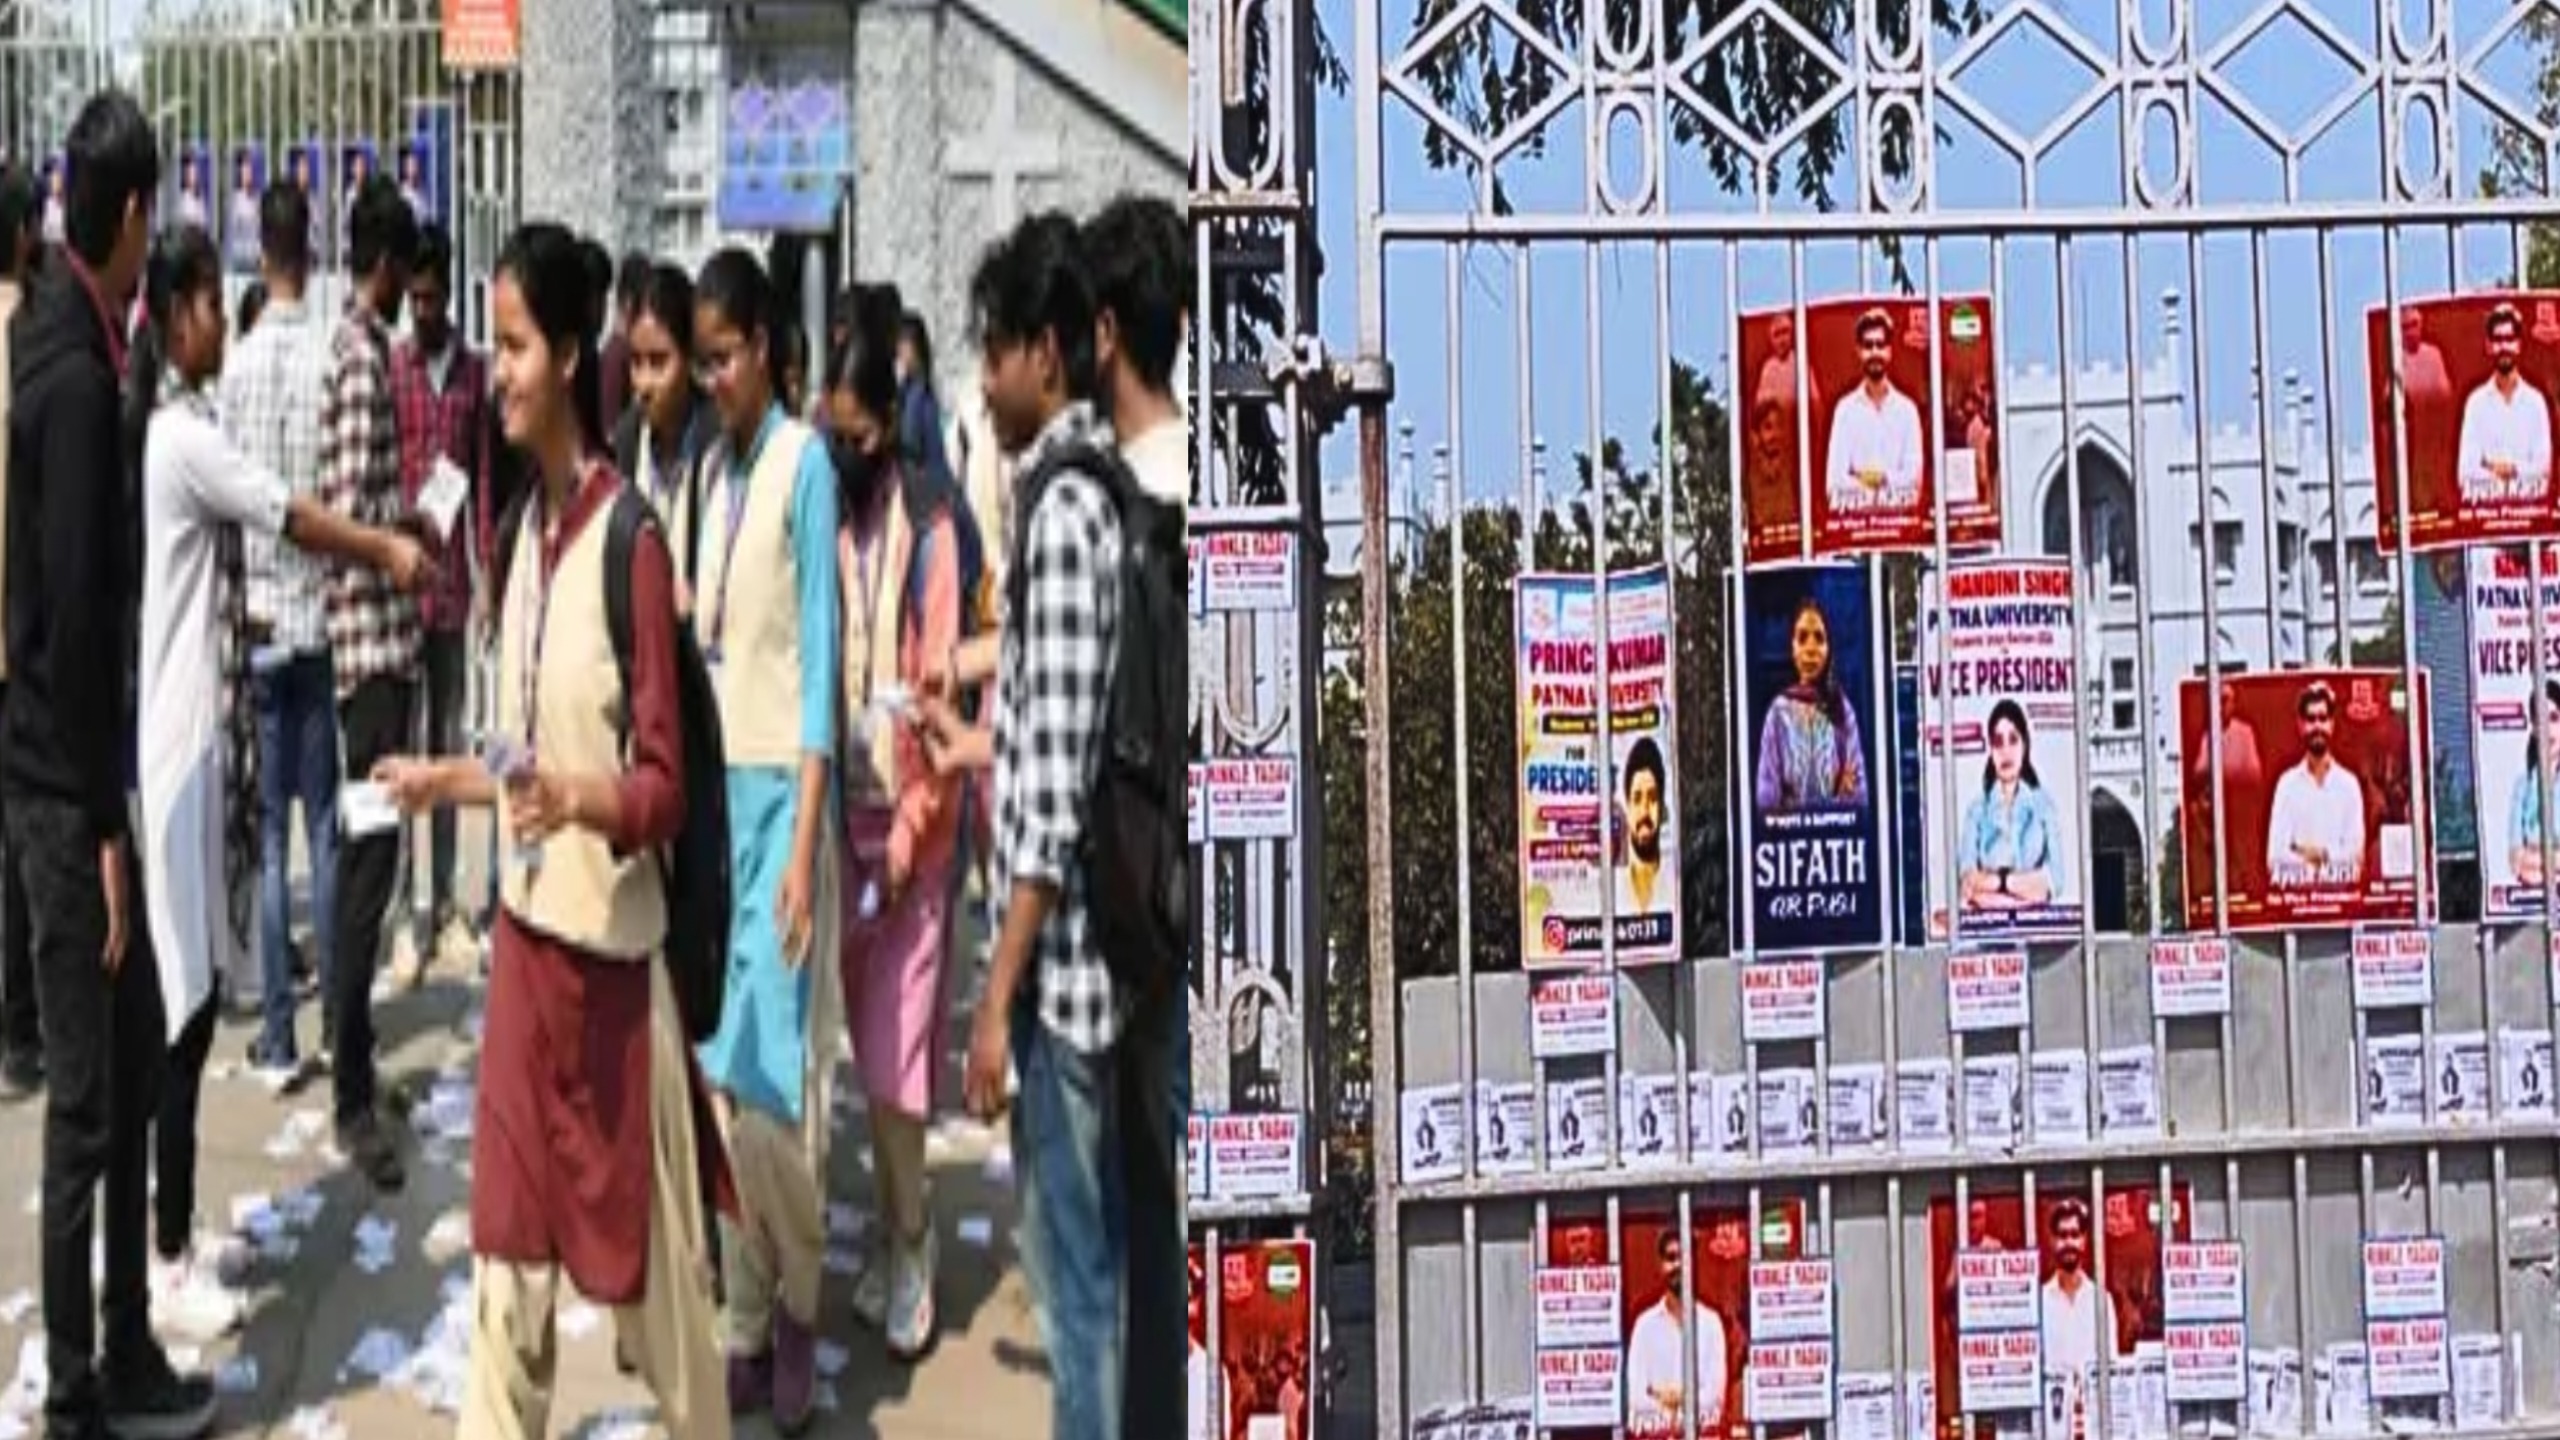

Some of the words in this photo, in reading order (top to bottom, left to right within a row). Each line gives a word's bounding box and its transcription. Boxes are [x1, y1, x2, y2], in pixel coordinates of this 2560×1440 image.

[1950, 571, 2020, 599] NANDINI
[2024, 569, 2073, 598] SINGH
[2477, 585, 2523, 609] PATNA
[1928, 604, 1983, 632] PTNA
[1529, 641, 1599, 675] PRINC
[2479, 639, 2513, 677] VICE
[1928, 660, 1971, 699] VCE
[1531, 684, 1586, 708] PATNA
[1528, 763, 1618, 795] PRESIDET
[1755, 838, 1867, 888] SIFATH
